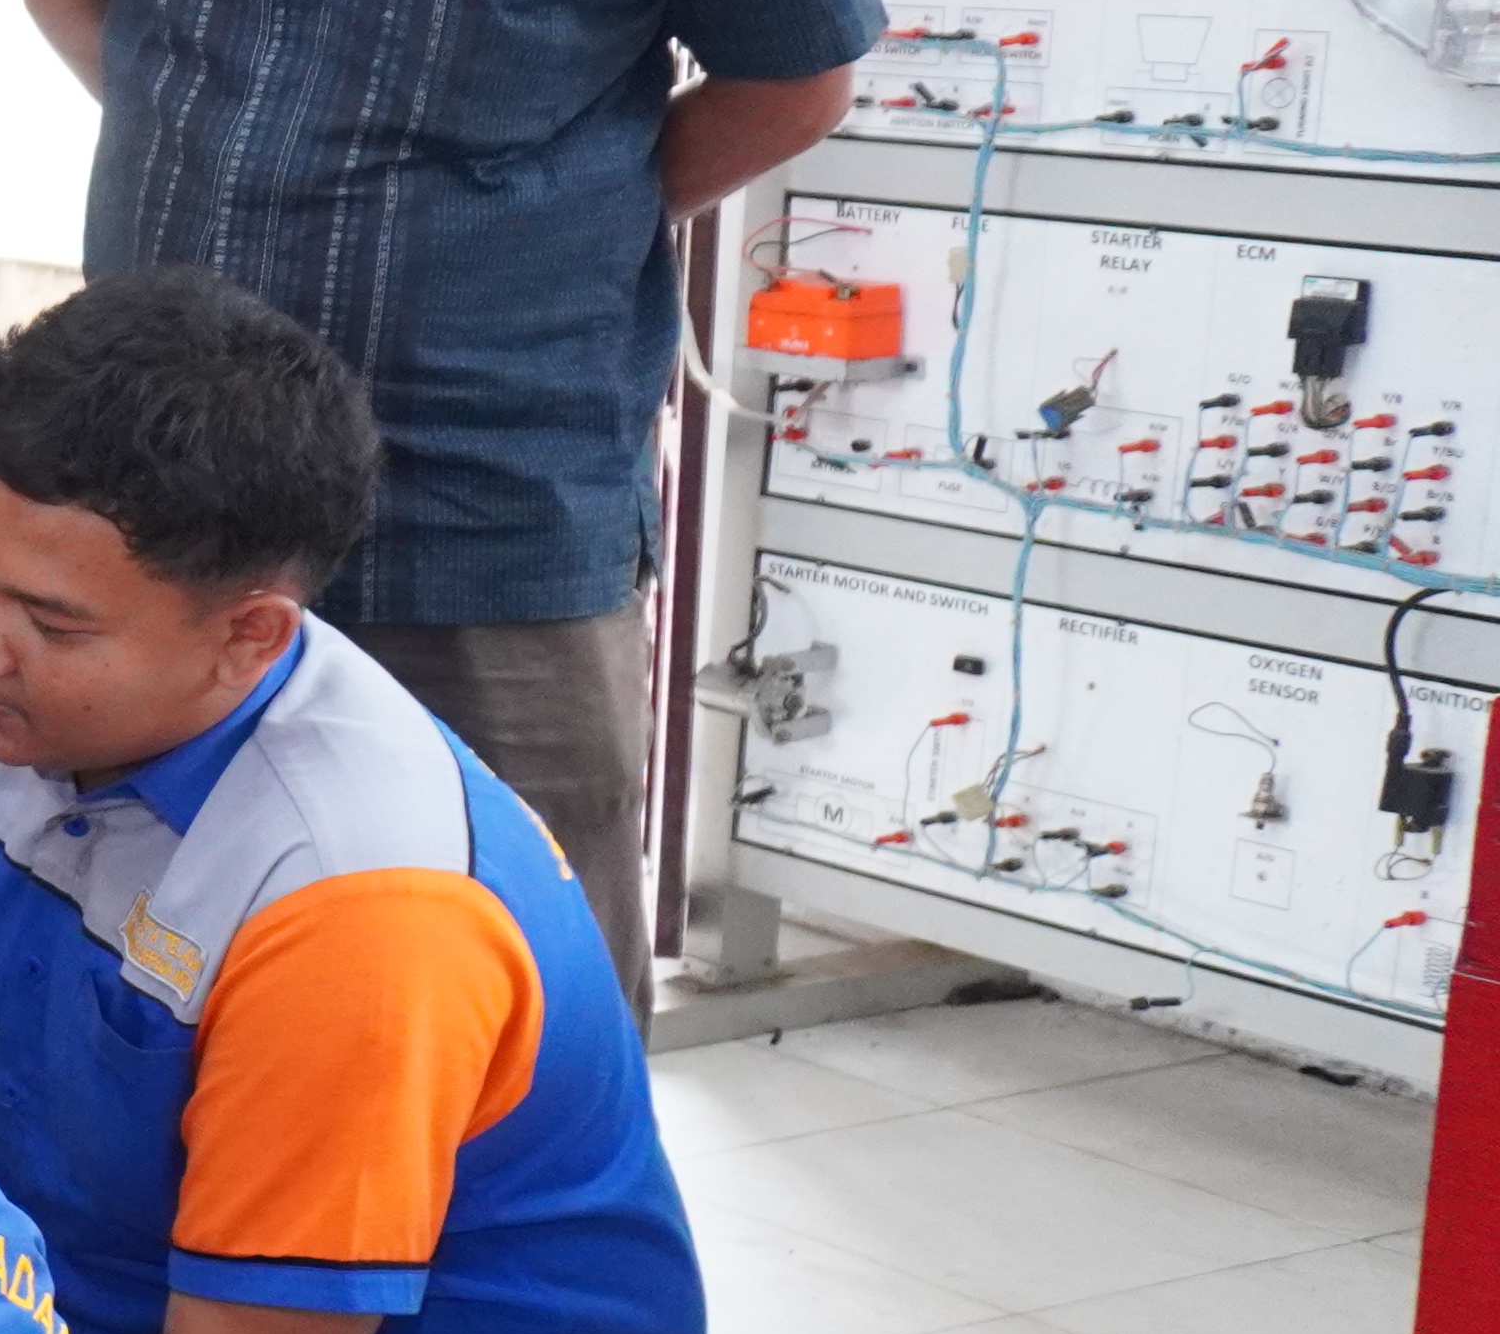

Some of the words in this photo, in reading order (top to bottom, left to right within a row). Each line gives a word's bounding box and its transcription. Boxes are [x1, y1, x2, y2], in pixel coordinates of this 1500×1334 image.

[835, 204, 901, 224] BATTERY
[952, 216, 990, 233] FUE
[1090, 229, 1163, 250] STARTER
[1236, 244, 1277, 262] ECM
[1100, 255, 1153, 273] RELAY
[768, 562, 830, 585] STARTER
[833, 575, 890, 596] MOTOR
[893, 585, 927, 604] AND
[930, 593, 990, 616] SWITCH
[1058, 617, 1140, 645] RECTIFIER
[1248, 653, 1323, 680] OXYGEN
[1248, 677, 1320, 704] SENSOR
[823, 803, 845, 825] M
